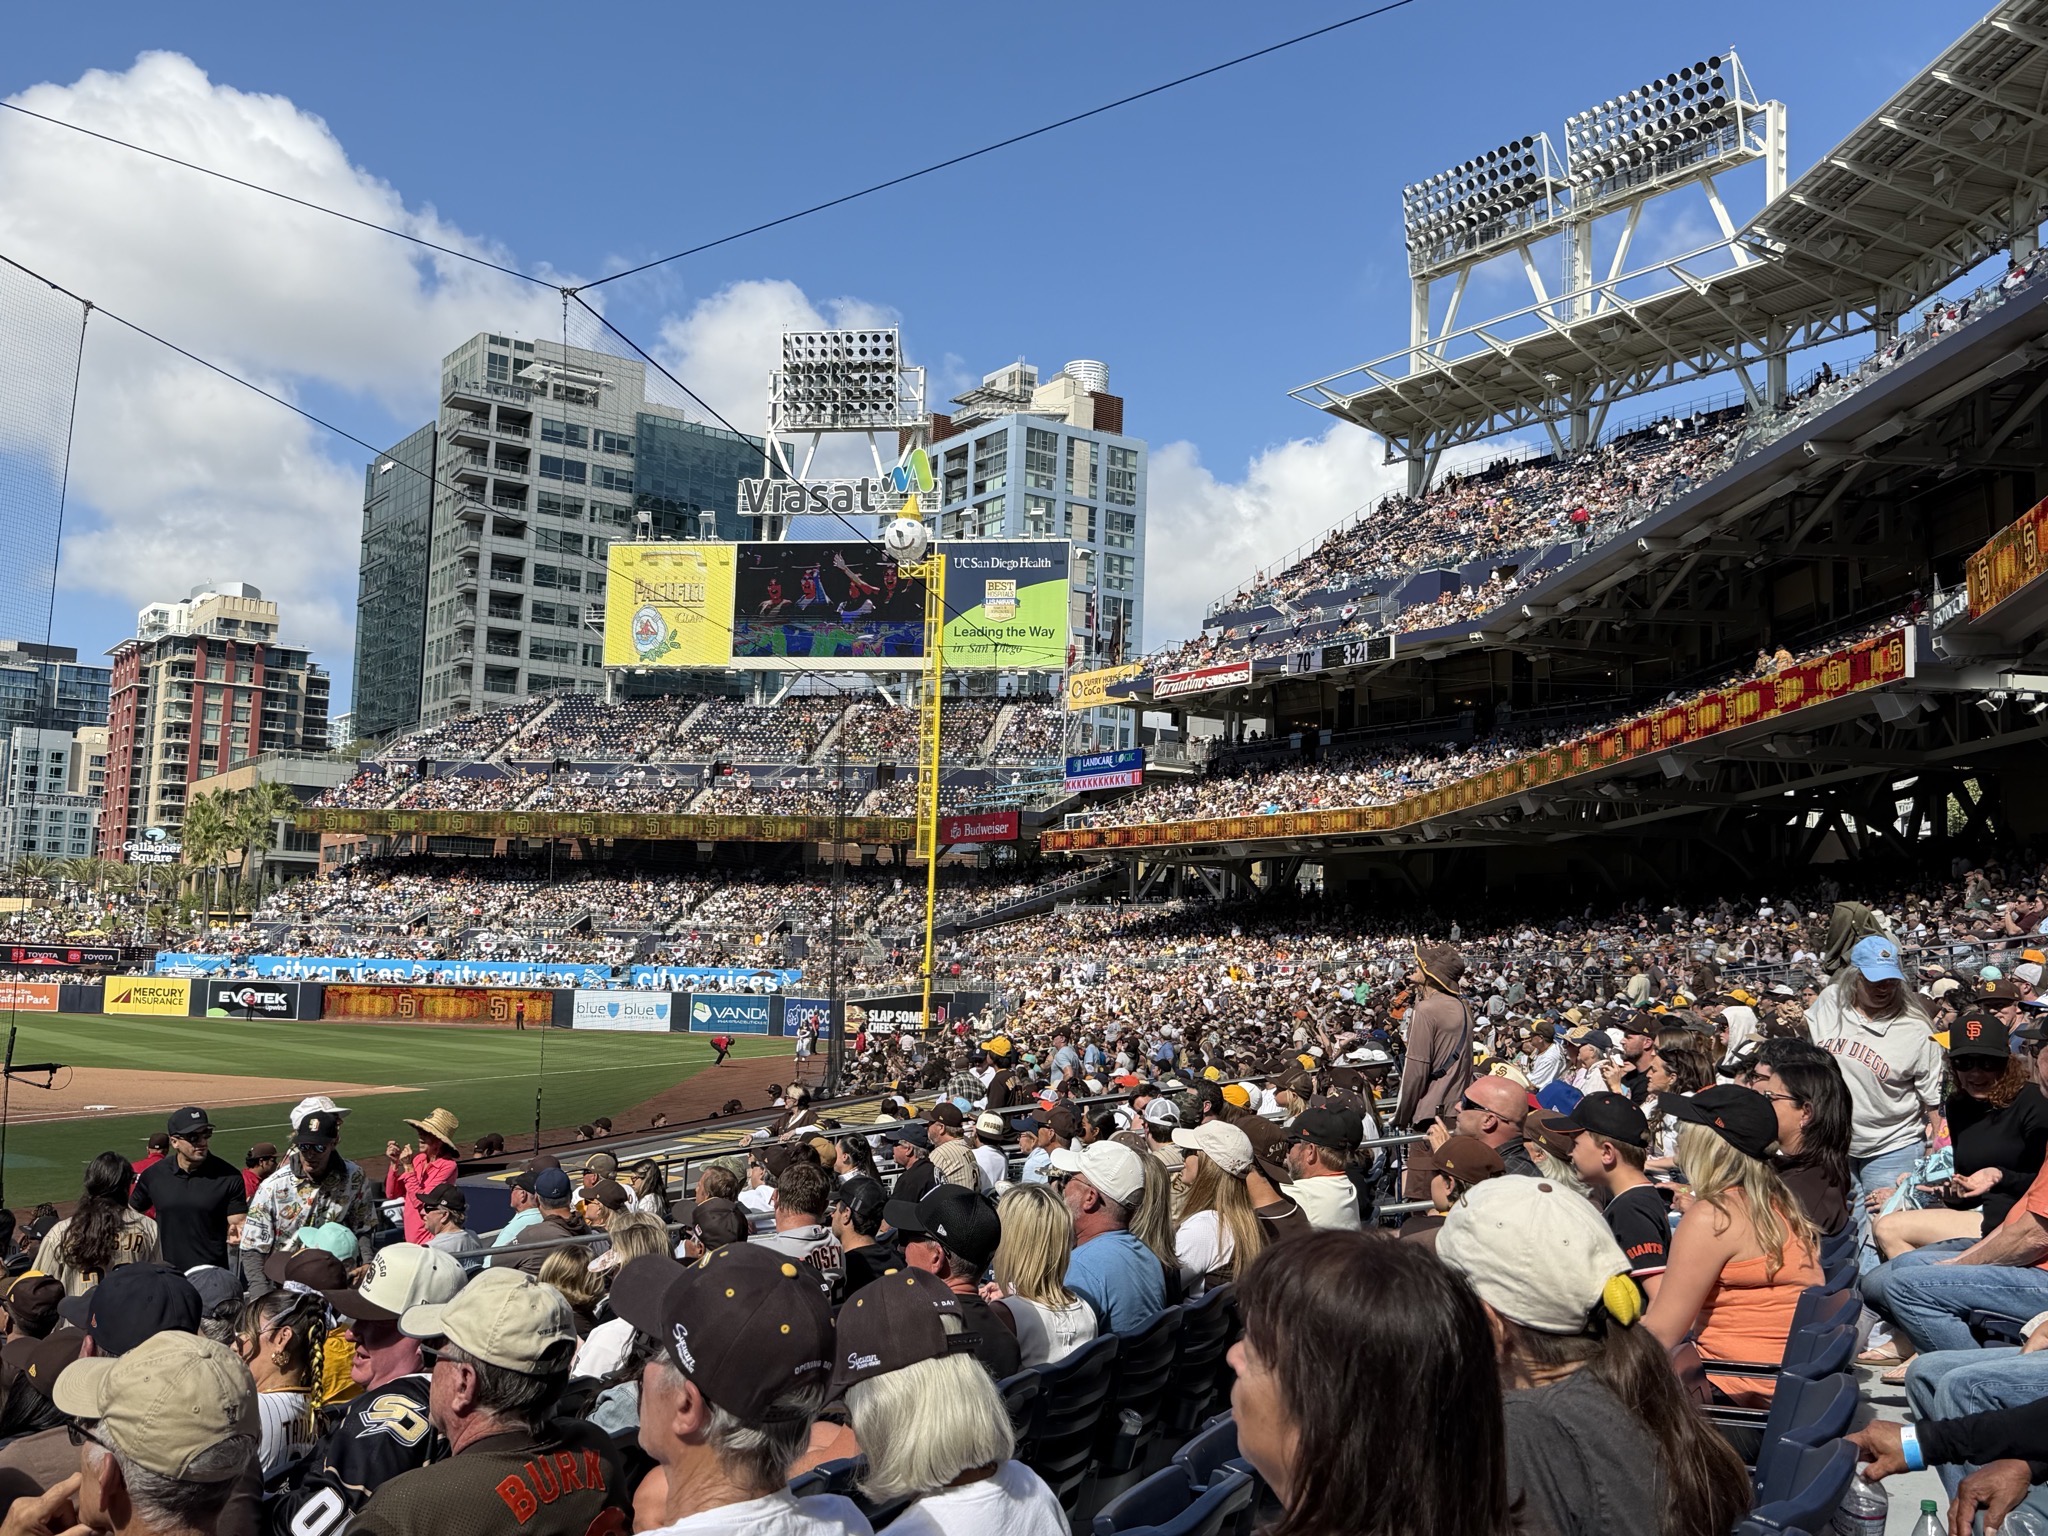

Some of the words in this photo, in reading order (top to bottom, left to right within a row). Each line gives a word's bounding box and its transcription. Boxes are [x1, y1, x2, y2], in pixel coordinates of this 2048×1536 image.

[742, 477, 876, 513] Viasat
[954, 557, 970, 569] UC
[971, 557, 989, 569] San
[991, 557, 1019, 570] Diego
[1019, 556, 1051, 568] Health
[988, 581, 1014, 590] BEST
[954, 626, 1004, 639] Leading
[1006, 626, 1026, 637] the
[1028, 626, 1055, 639] Way
[952, 643, 964, 653] in
[967, 643, 988, 653] San
[1343, 641, 1368, 665] 3:21
[1083, 677, 1101, 687] CURRY
[1155, 674, 1204, 694] Tarantino
[1083, 755, 1113, 768] LANDCARE
[964, 822, 1009, 837] Budweiser
[122, 840, 182, 858] Gallagher
[129, 851, 172, 863] Square
[27, 951, 58, 959] TOYOTA
[83, 953, 114, 961] TOYOTA
[638, 969, 778, 992] citycuises
[133, 987, 184, 998] MERCURY
[26, 995, 50, 1005] Park
[132, 996, 184, 1006] INSURANCE
[576, 1002, 606, 1014] blue
[624, 1003, 654, 1015] blue
[713, 1007, 768, 1019] VANDA
[868, 1010, 895, 1022] SLAP
[896, 1011, 924, 1022] SOME
[868, 1023, 896, 1034] CHEES
[1849, 1043, 1890, 1083] DIEGO
[1626, 1242, 1663, 1260] GIANTS
[804, 1246, 843, 1271] POSEY
[941, 1299, 955, 1307] DAY
